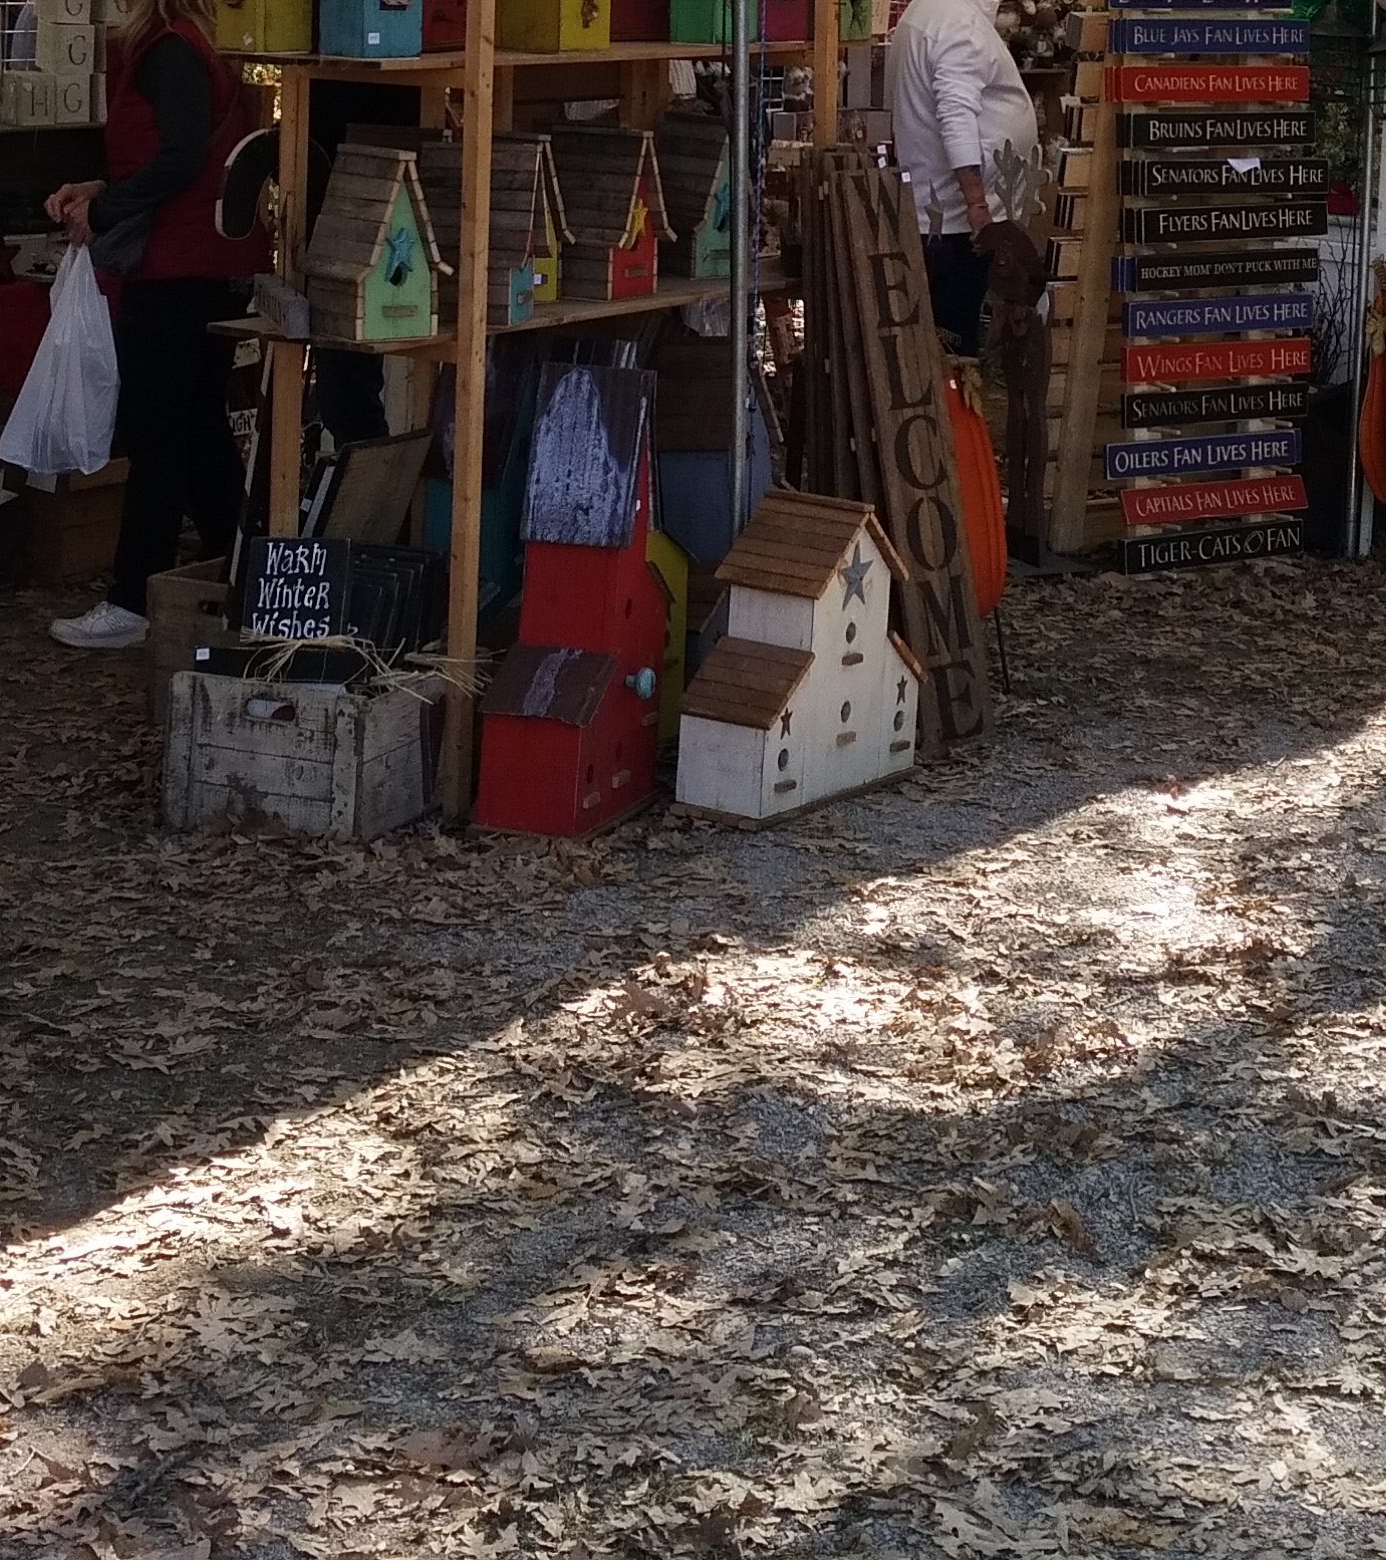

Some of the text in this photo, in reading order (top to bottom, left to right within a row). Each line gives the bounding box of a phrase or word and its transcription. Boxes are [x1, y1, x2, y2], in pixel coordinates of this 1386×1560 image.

[1134, 25, 1305, 46] BLUE JAYS FAN LIVES HERE
[1134, 74, 1299, 93] CANADIENS FAN LIVES HERE
[1149, 119, 1307, 141] BRUINS FAN LIVES HERE
[1152, 164, 1218, 186] SENATORS
[1221, 165, 1249, 185] FAN
[1289, 165, 1324, 185] HERE
[1159, 208, 1313, 234] FLYERS FAN LIVES HERE
[1141, 265, 1183, 280] HOCKEY
[1245, 261, 1272, 274] PUCK
[1273, 259, 1300, 271] WITH
[1302, 258, 1317, 269] ME
[1136, 302, 1308, 330] RANGERS FAN LIVES HERE
[1137, 348, 1308, 378] WINGS FAN LIVES HERE
[1132, 391, 1303, 421] SENATORS FAN LIVES HERE
[852, 173, 986, 742] WELCOME
[1115, 440, 1289, 473] OILERS FAN LIVES HERE
[1135, 485, 1296, 517] CAPITALS FAN LIVES HERE
[1138, 527, 1301, 568] TIGER-CATS FAN
[252, 610, 331, 639] Wishes
